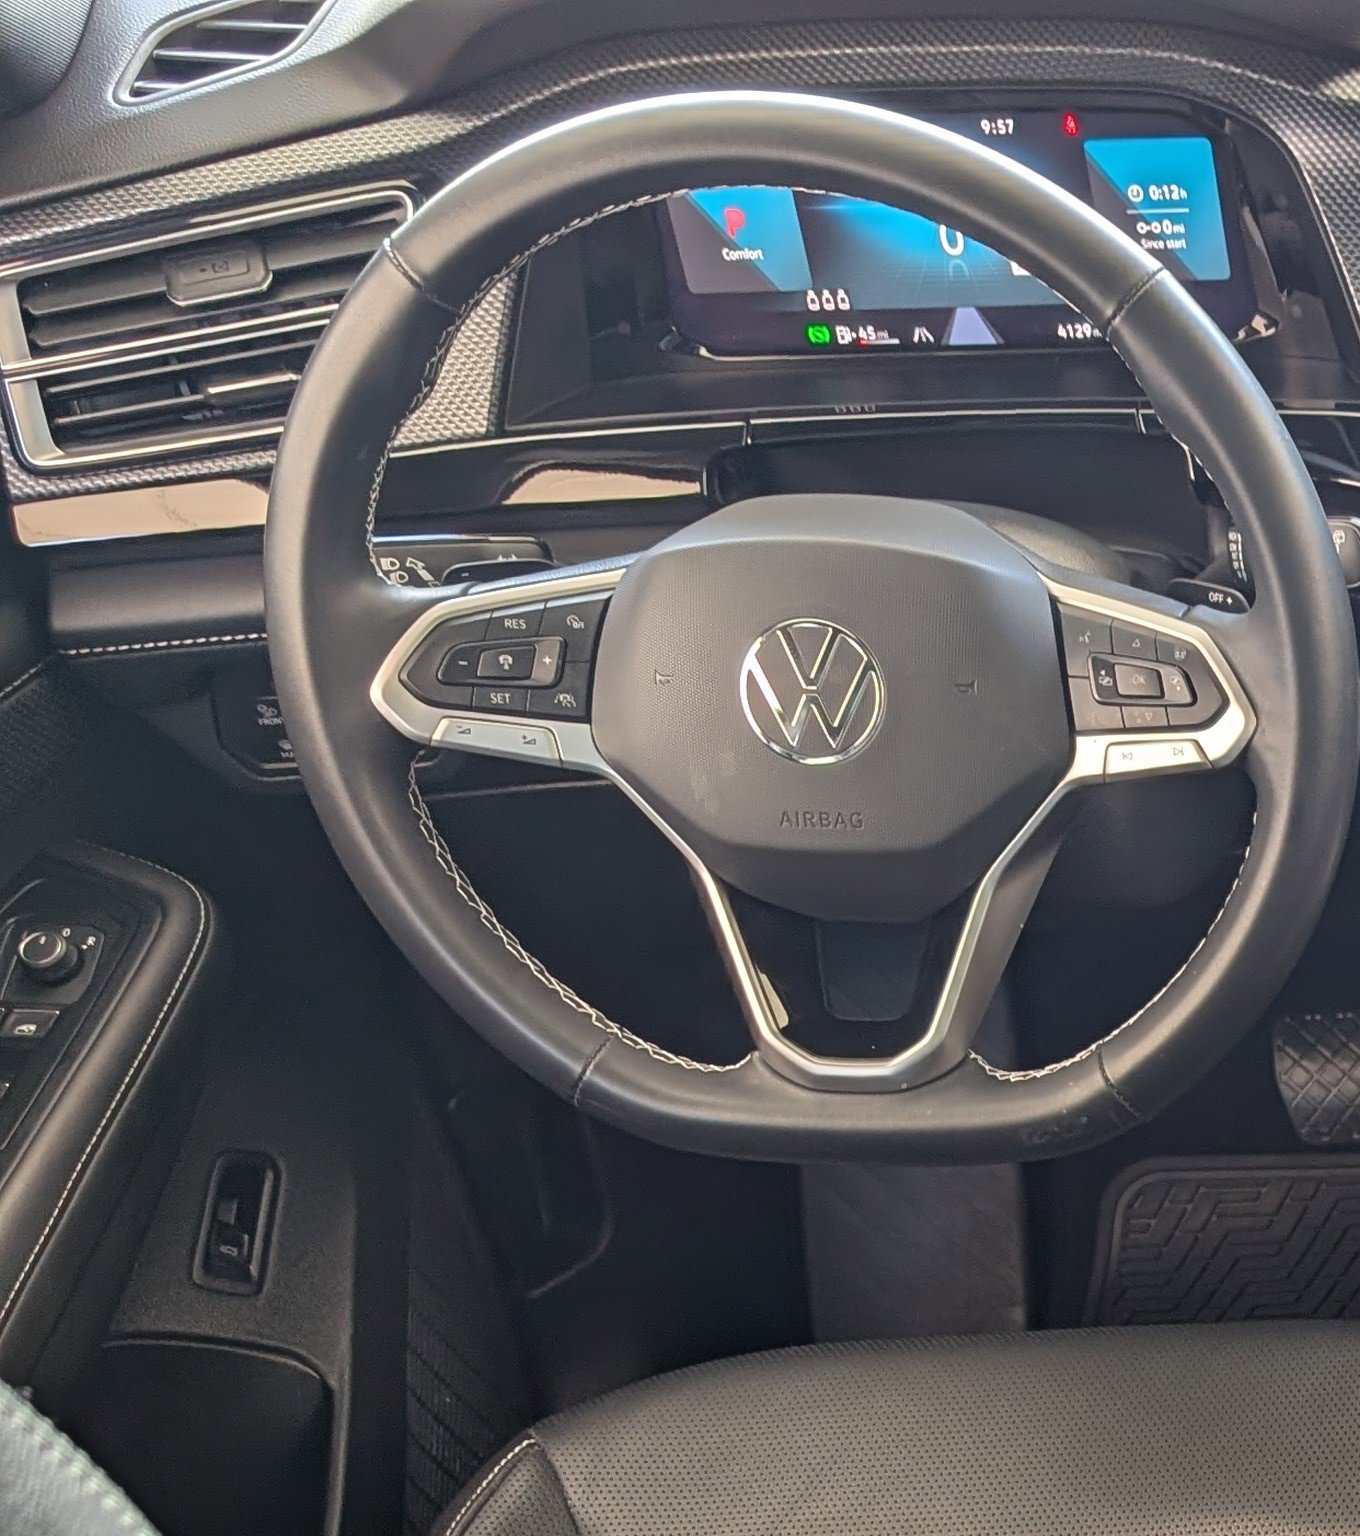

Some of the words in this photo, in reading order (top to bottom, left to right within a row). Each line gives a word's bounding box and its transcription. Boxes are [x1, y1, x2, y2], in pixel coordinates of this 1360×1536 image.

[980, 118, 1014, 135] 9:57
[724, 207, 745, 238] P
[721, 247, 763, 261] Comfort
[1208, 592, 1224, 603] OFF
[504, 618, 526, 630] RES
[1132, 674, 1146, 685] OK
[490, 693, 511, 704] SET
[779, 810, 864, 829] AIRBAG
